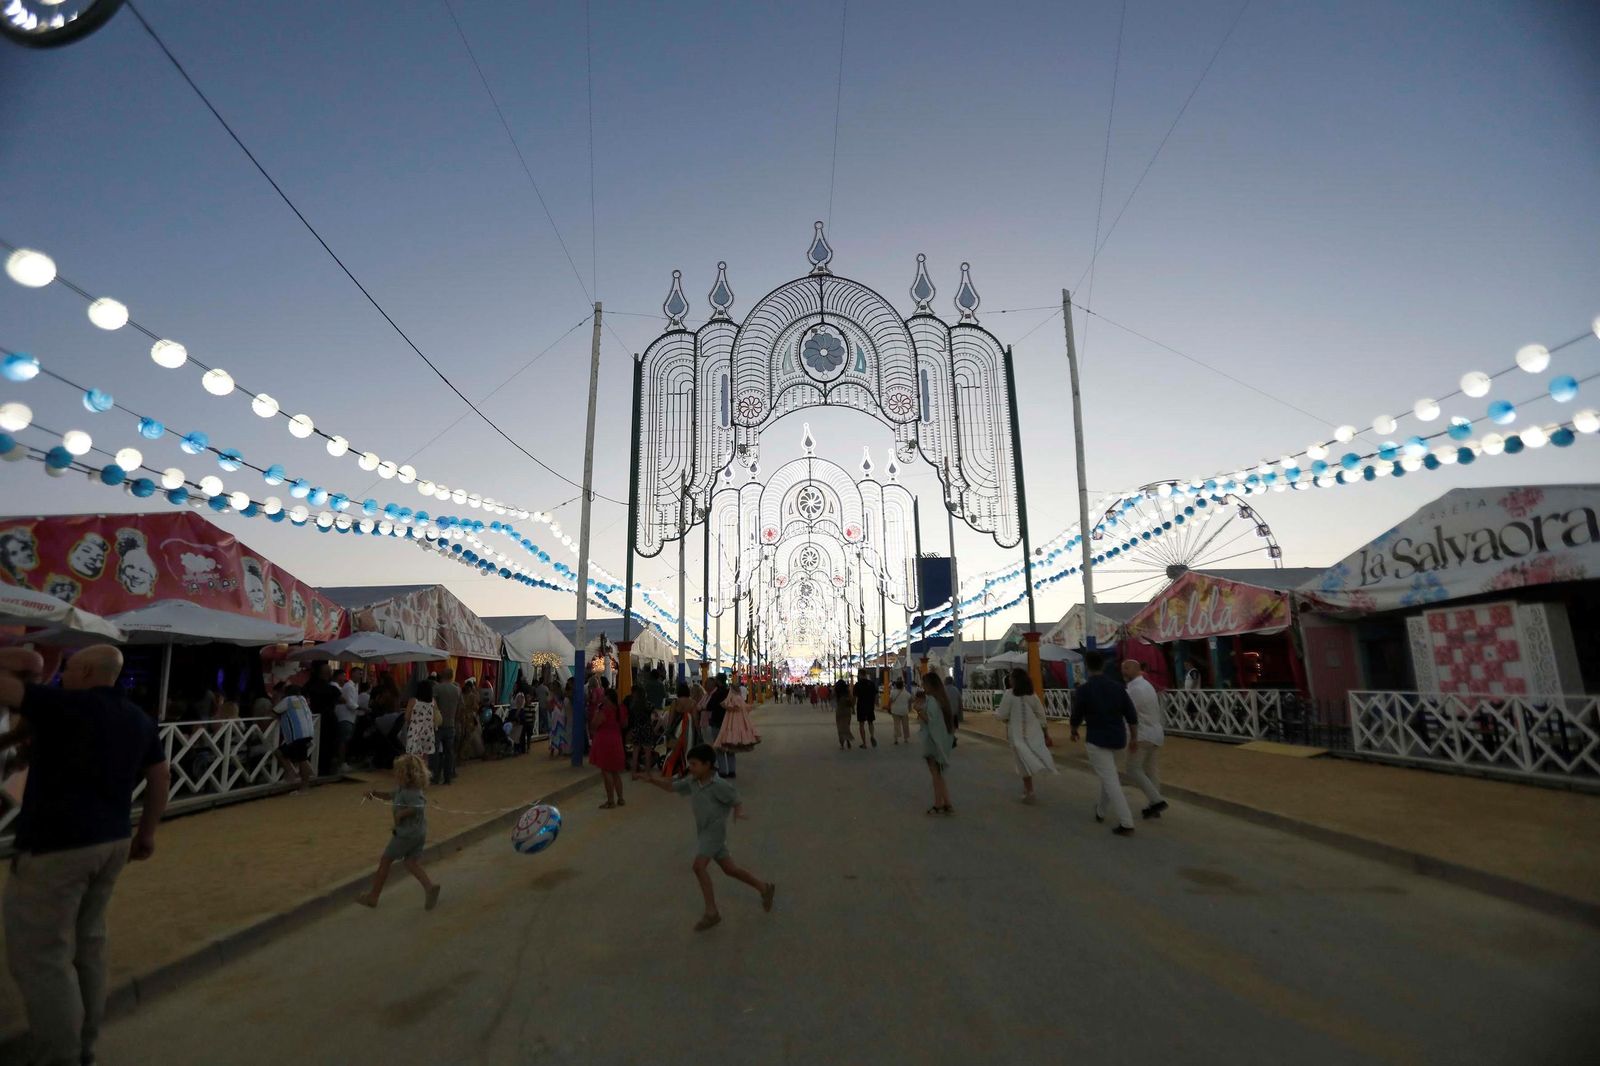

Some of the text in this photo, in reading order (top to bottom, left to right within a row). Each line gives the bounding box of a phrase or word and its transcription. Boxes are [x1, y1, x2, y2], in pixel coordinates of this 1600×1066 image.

[1418, 498, 1488, 525] CASETA
[1360, 506, 1600, 587] La Salvaora
[1160, 585, 1239, 639] la lola
